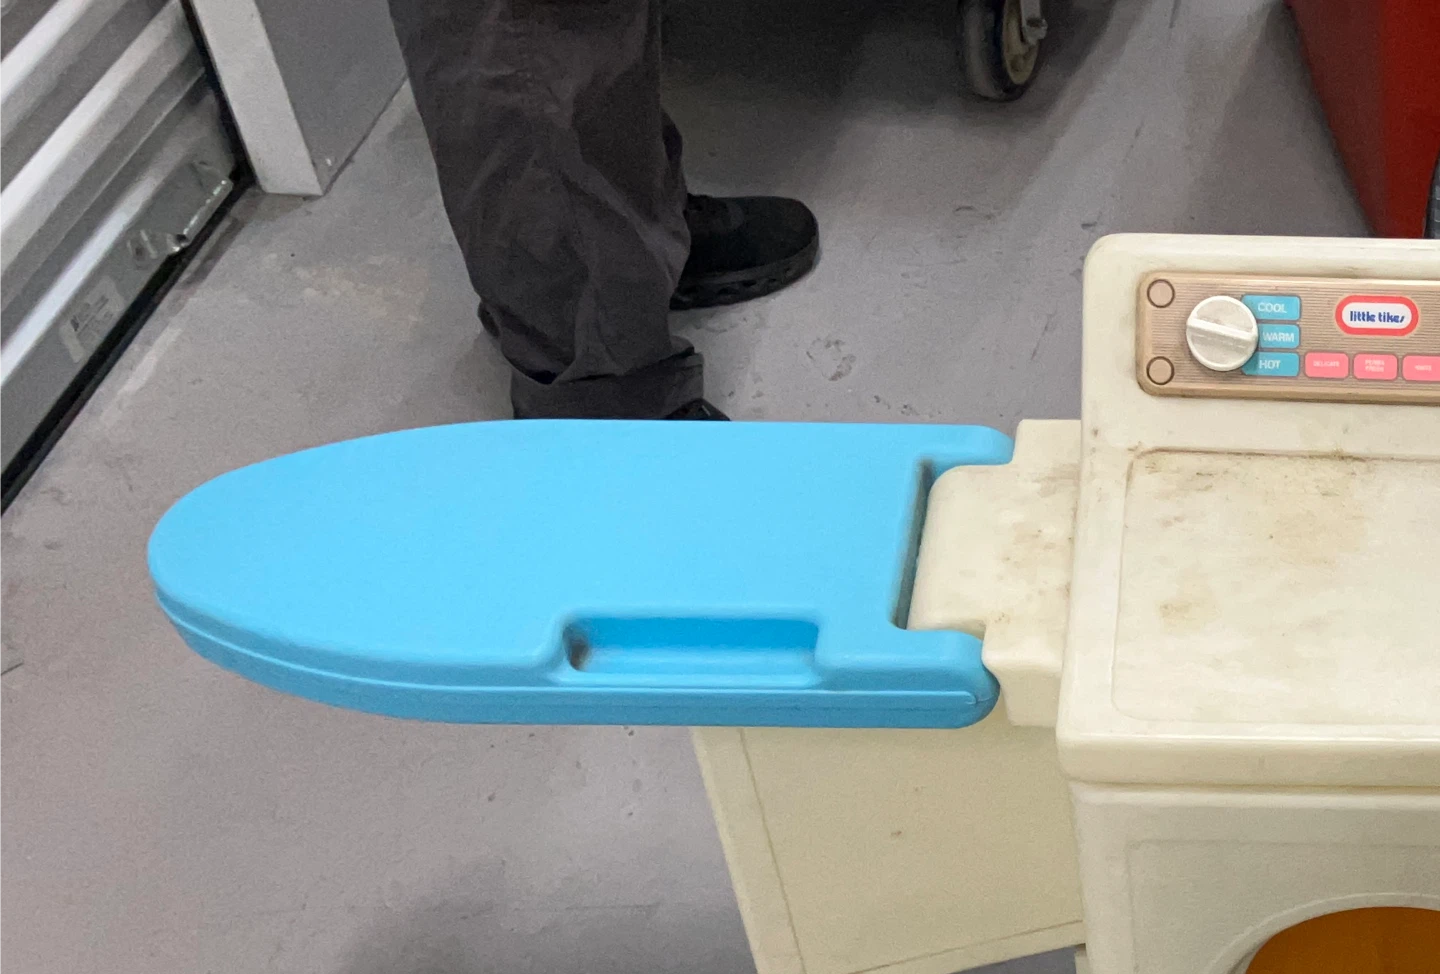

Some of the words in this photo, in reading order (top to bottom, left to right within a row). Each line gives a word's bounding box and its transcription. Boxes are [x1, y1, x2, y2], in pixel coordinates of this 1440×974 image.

[1257, 303, 1288, 314] COOL
[1350, 310, 1376, 323] little
[1378, 311, 1405, 323] tikes
[1262, 331, 1295, 343] WARM
[1259, 359, 1281, 370] HOT
